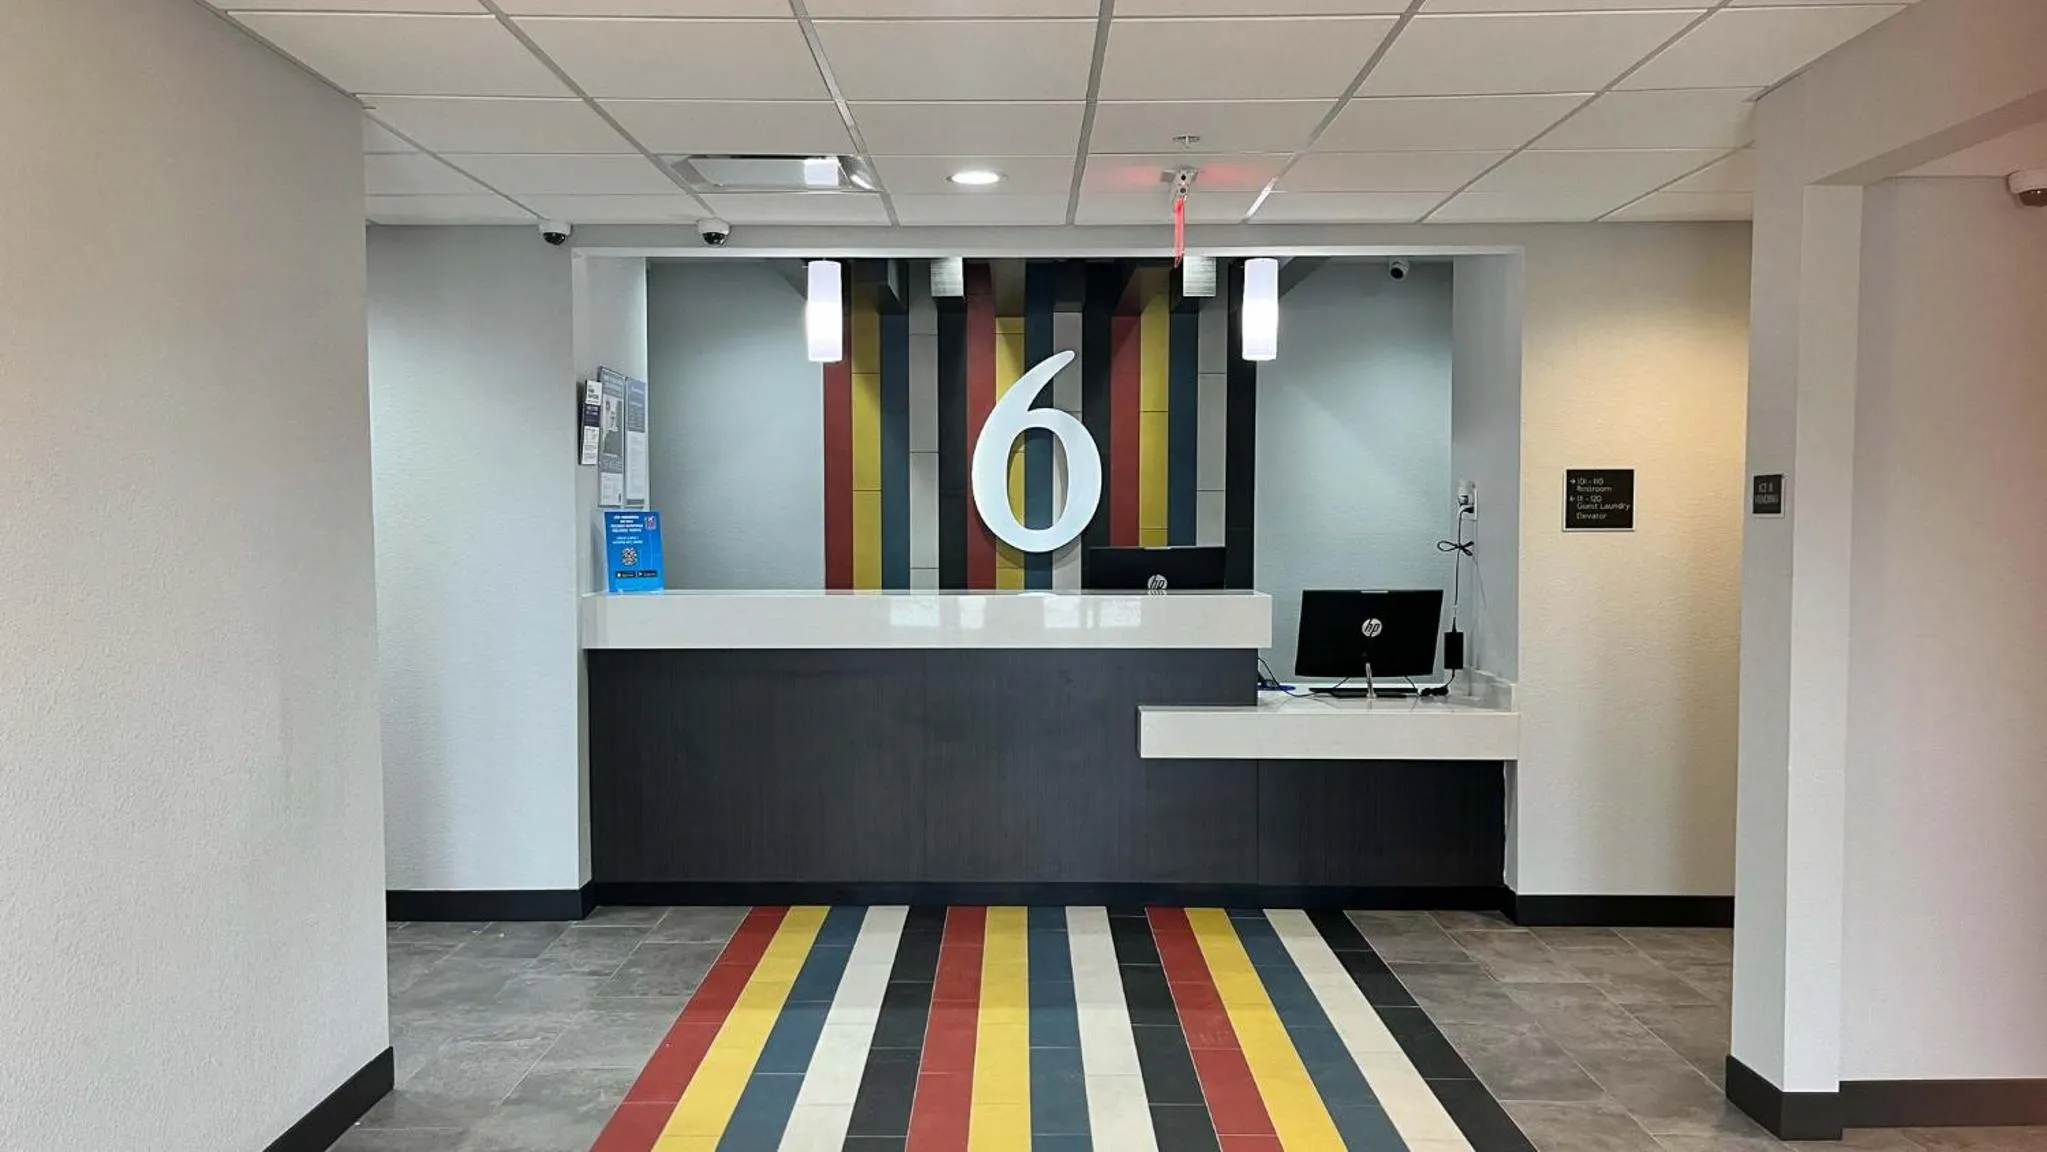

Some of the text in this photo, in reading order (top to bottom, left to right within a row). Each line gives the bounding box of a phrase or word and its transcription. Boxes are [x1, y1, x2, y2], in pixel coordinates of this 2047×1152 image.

[972, 350, 1102, 553] 6
[1600, 502, 1630, 511] Laundry
[1362, 618, 1382, 637] hp
